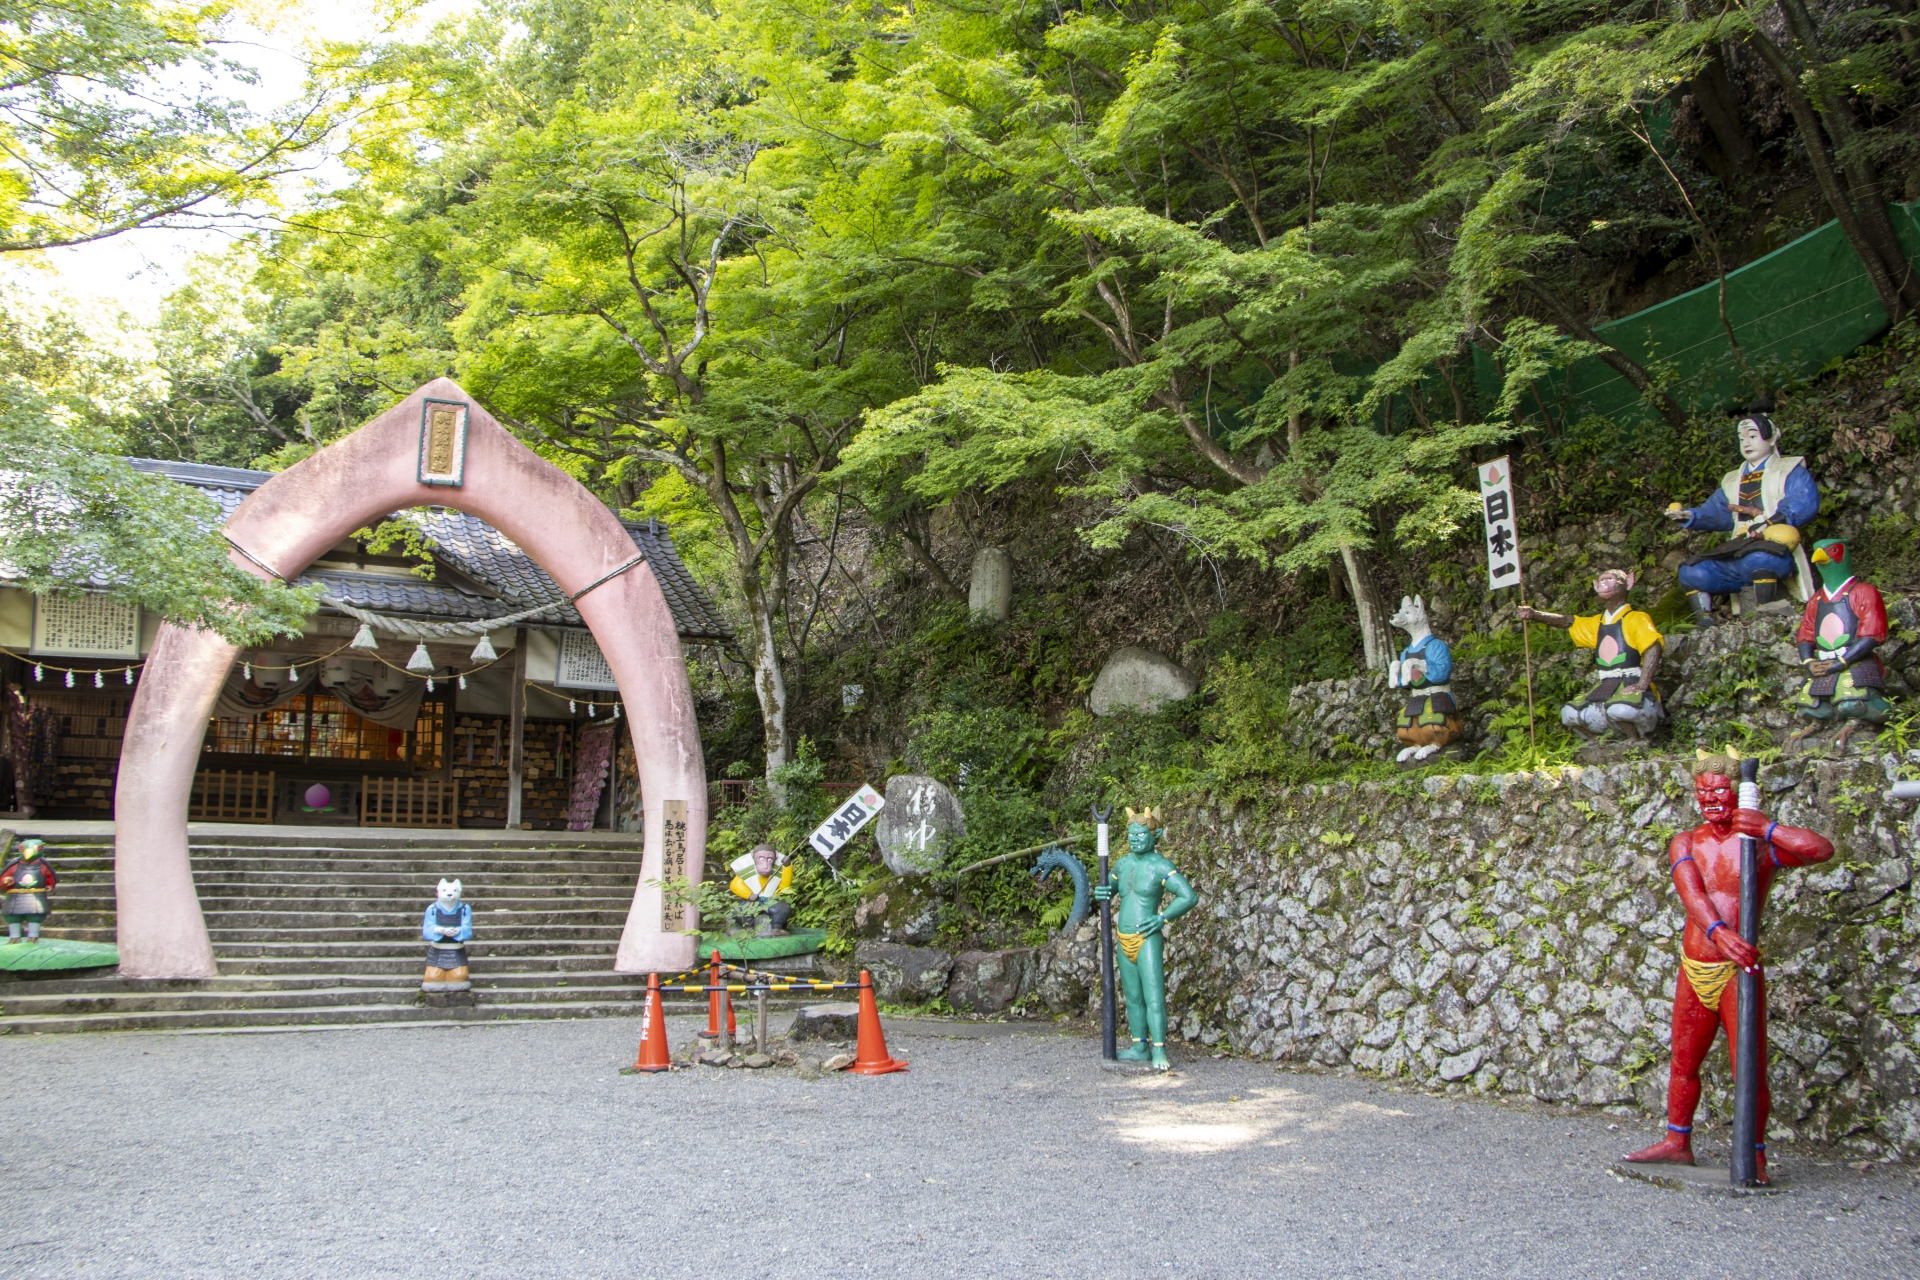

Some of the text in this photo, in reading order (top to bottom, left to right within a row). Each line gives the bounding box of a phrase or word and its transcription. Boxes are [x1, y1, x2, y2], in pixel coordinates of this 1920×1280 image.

[1486, 490, 1516, 578] 日本一
[816, 803, 867, 852] 日本一
[641, 996, 652, 1040] 立入禁止
